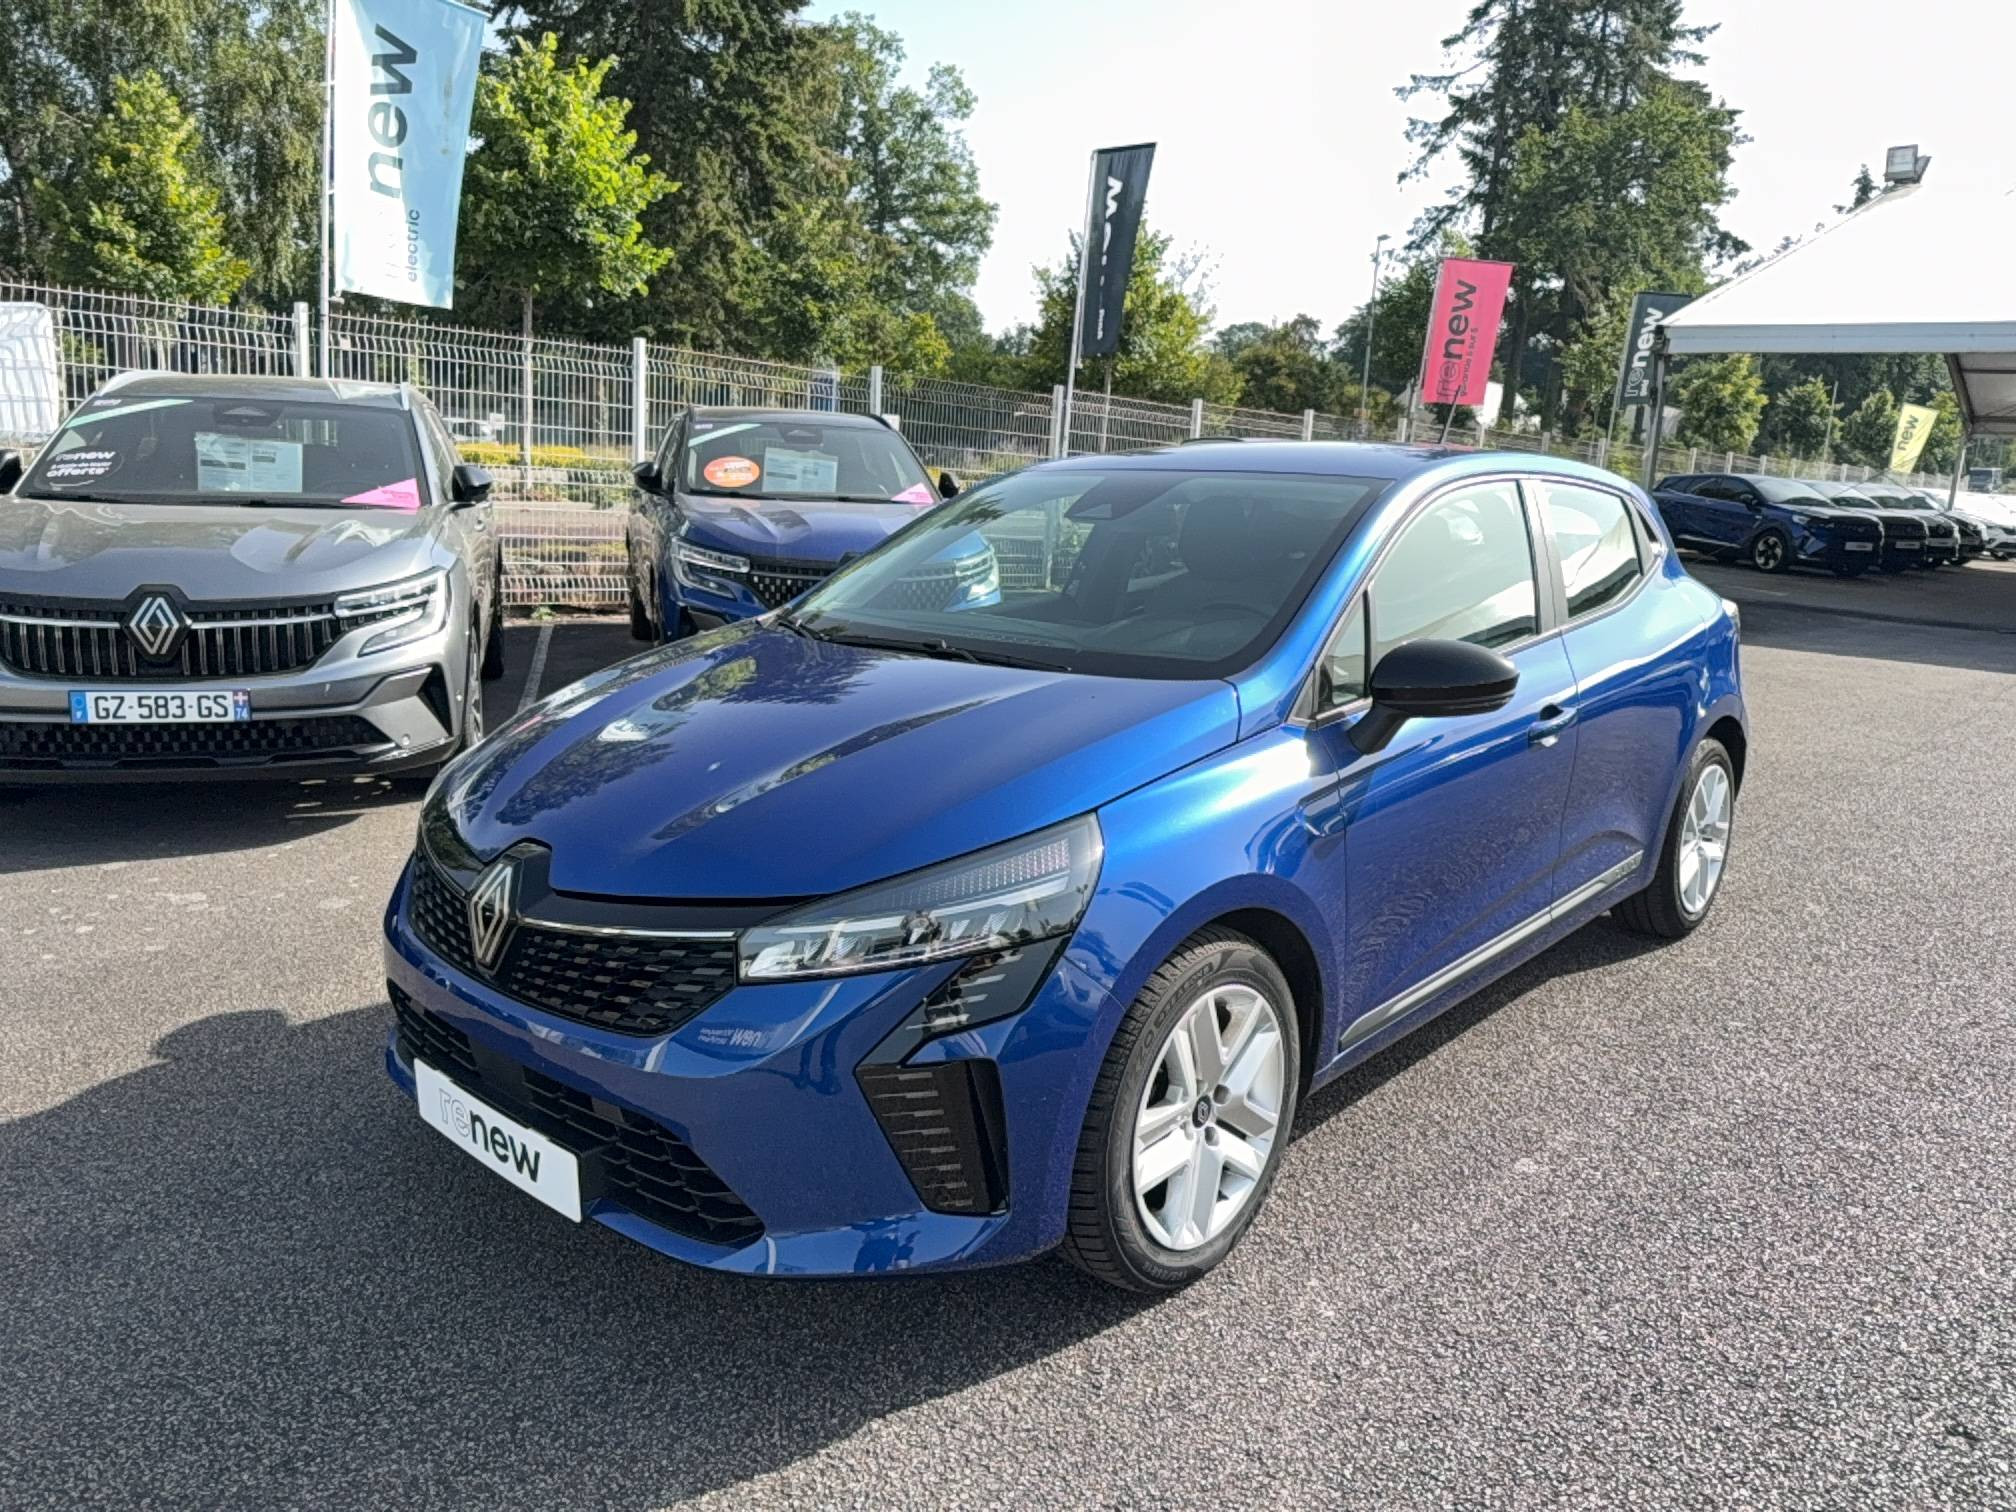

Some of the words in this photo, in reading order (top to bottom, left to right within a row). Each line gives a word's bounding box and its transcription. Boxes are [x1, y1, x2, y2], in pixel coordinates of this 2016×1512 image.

[407, 208, 421, 282] electric
[1437, 279, 1478, 397] renew
[1624, 307, 1664, 398] renew
[94, 694, 229, 720] GZ-583-GS
[236, 706, 248, 720] 74
[438, 1087, 541, 1183] renew
